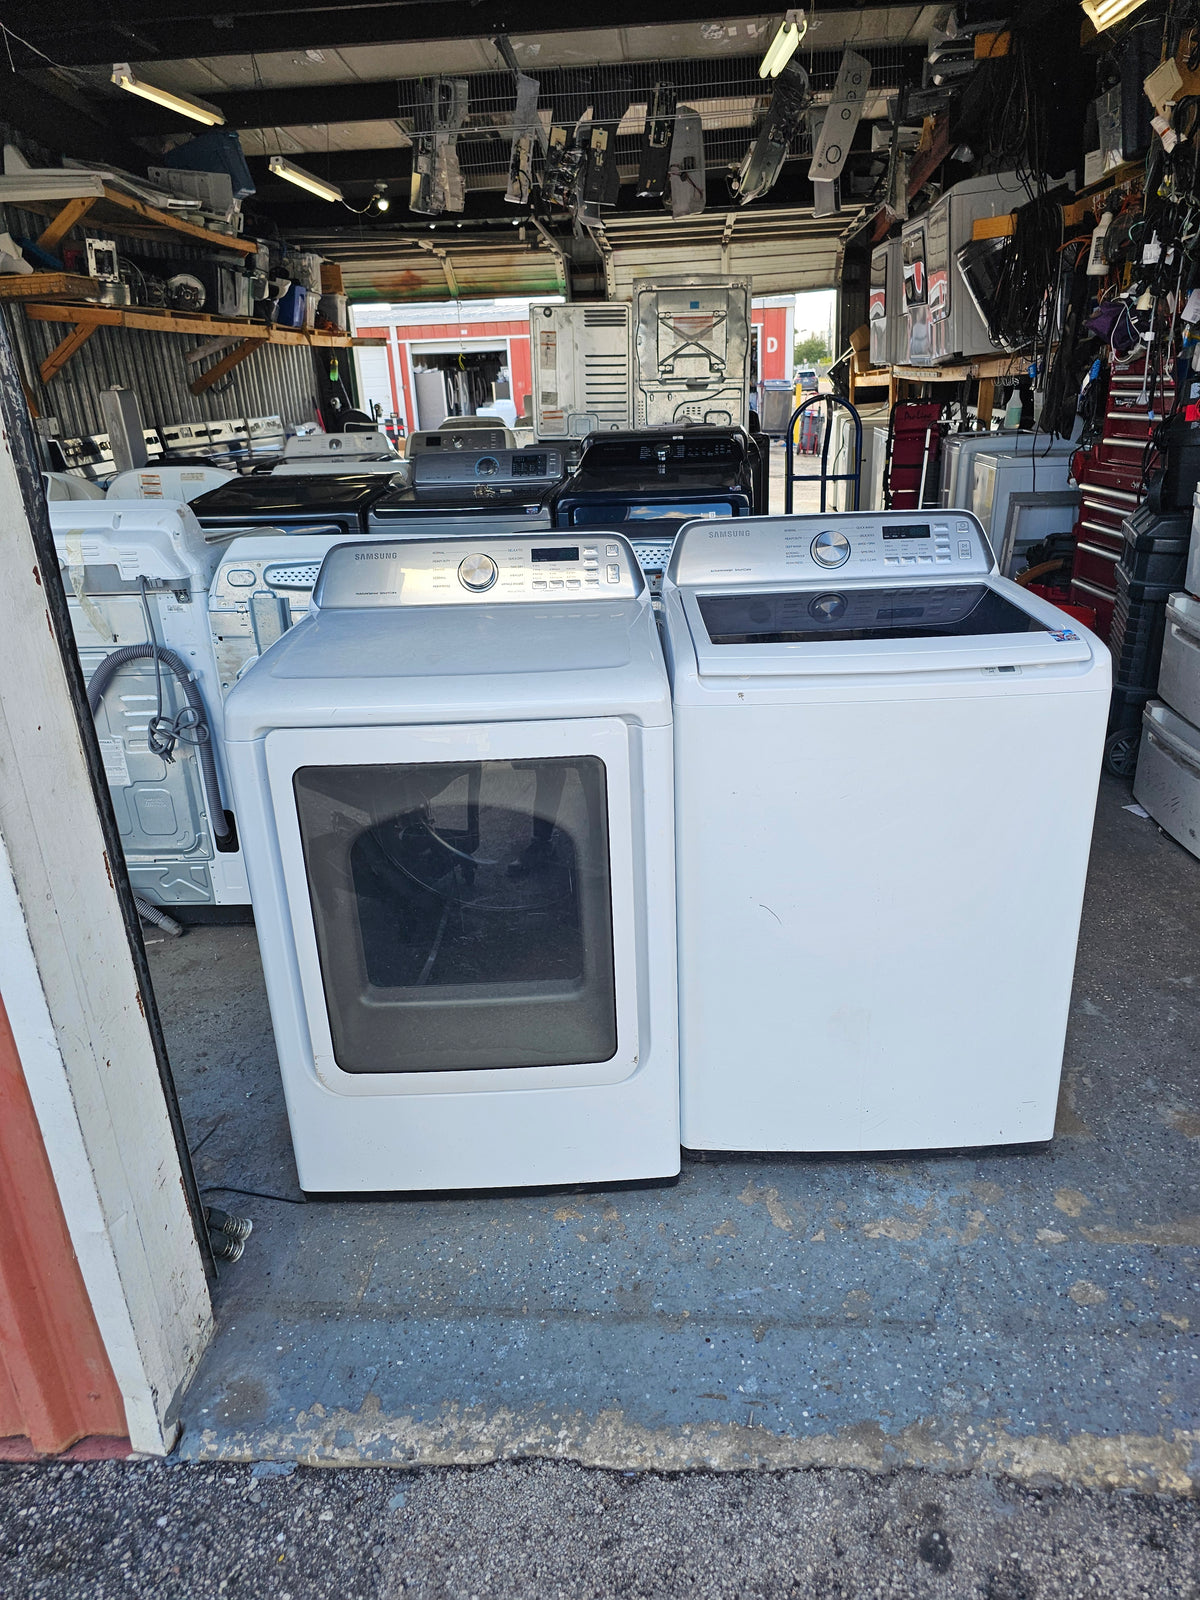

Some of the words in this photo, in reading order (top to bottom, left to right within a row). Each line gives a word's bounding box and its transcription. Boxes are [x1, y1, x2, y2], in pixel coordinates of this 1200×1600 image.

[766, 336, 778, 353] D
[708, 530, 751, 539] SAMSUNG
[354, 552, 398, 561] SAMSUNG
